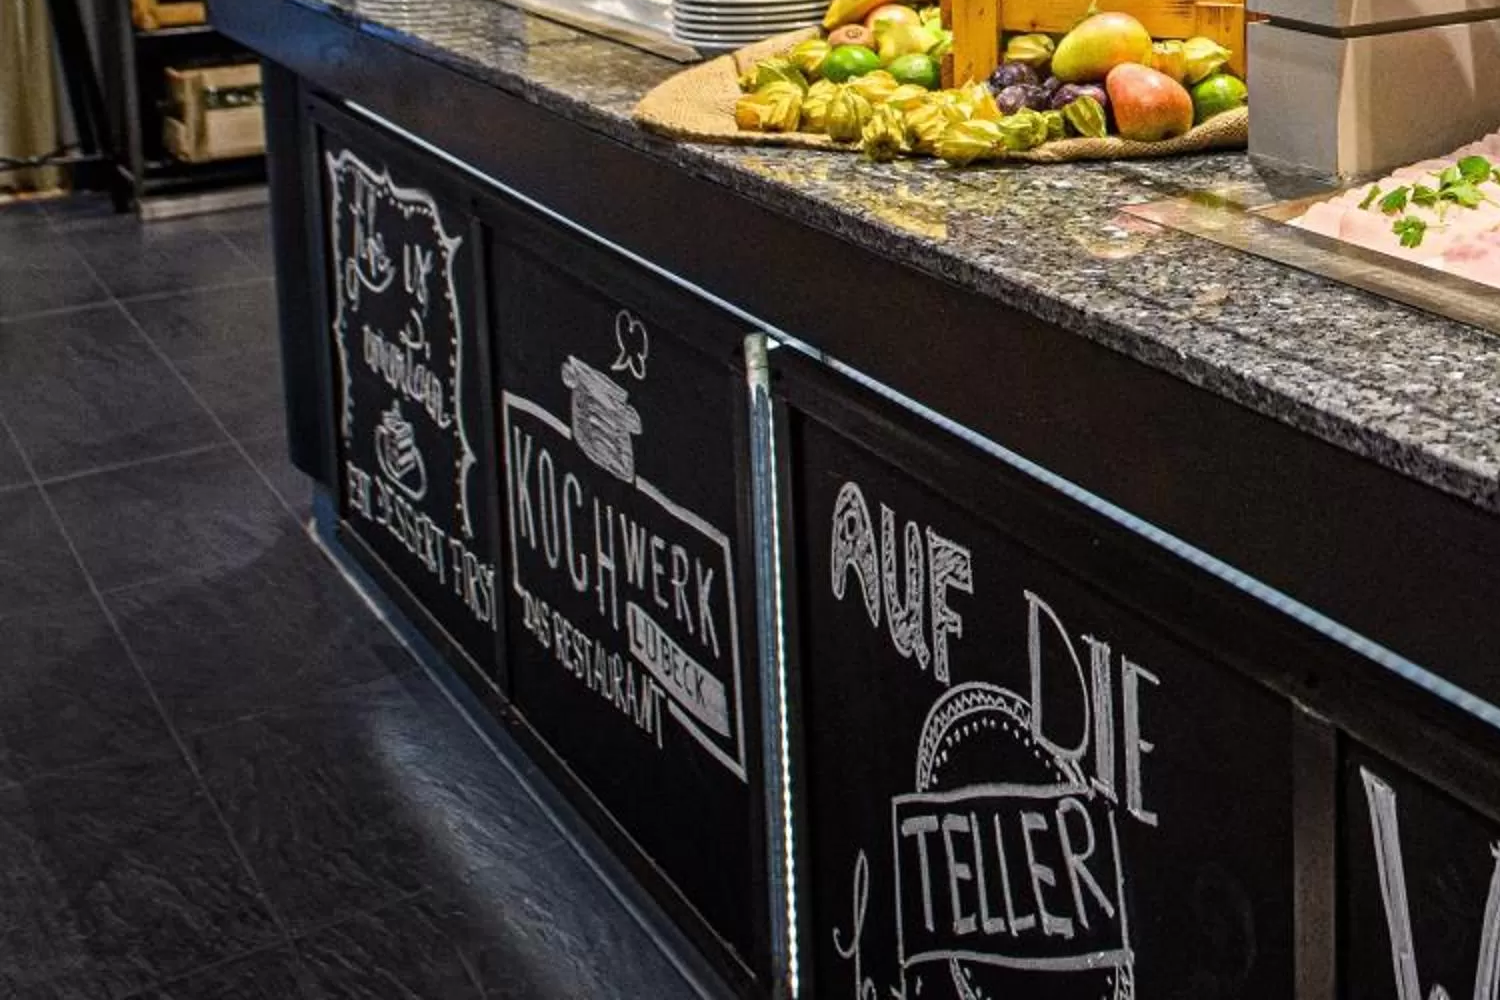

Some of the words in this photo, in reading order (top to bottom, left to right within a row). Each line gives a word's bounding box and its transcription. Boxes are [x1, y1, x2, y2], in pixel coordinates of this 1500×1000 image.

[513, 426, 721, 659] KOCHWERK
[830, 480, 973, 684] AUF
[522, 590, 550, 649] DAS
[551, 612, 667, 749] RESTAURANT
[1024, 588, 1161, 826] DIE
[901, 798, 1114, 939] TELLER
